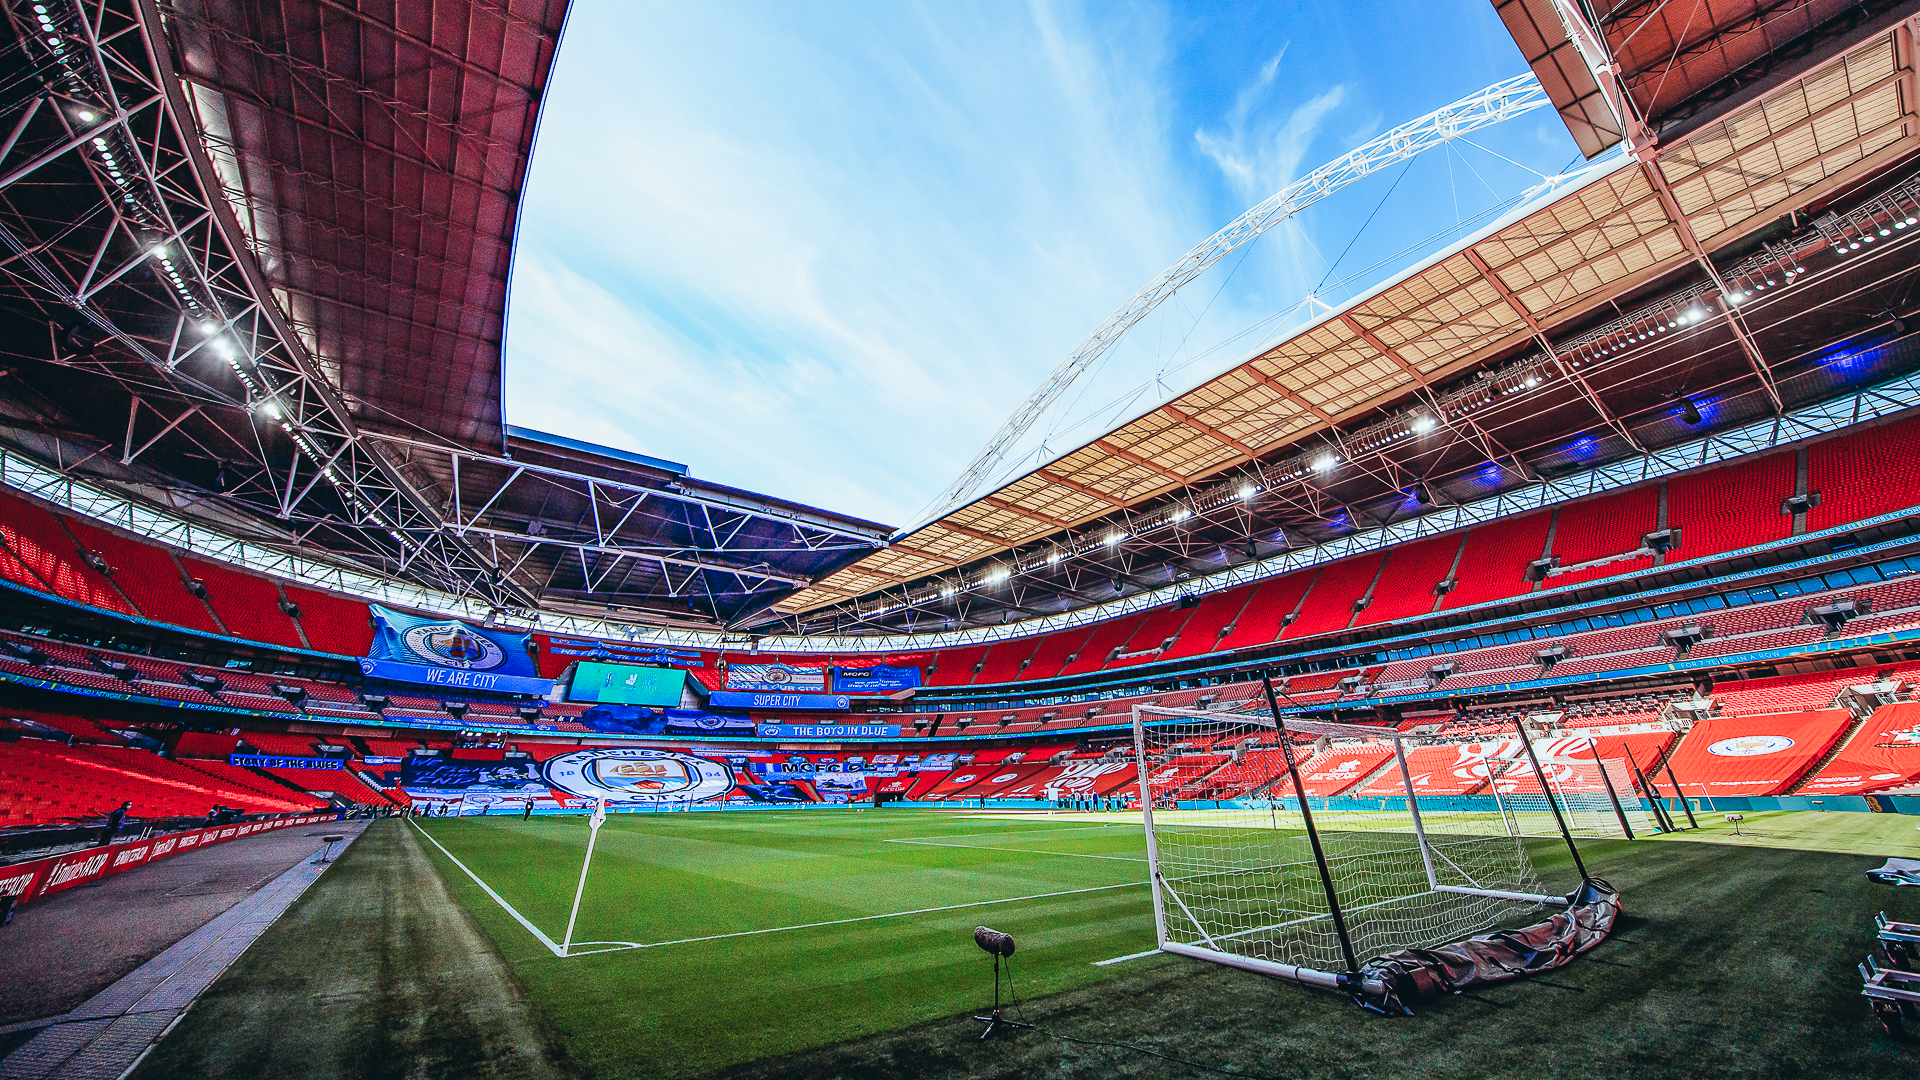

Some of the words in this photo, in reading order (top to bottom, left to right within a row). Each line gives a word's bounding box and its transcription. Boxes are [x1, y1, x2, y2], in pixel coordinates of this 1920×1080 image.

[1861, 511, 1899, 527] WEMBLEY
[1757, 538, 1790, 553] WEMBLEY
[1791, 527, 1836, 545] CONNECTED
[1832, 545, 1865, 560] WEMBLEY
[1868, 535, 1914, 552] CONNECTED
[1706, 656, 1735, 666] YEARS
[426, 669, 444, 683] WE
[446, 671, 470, 686] ARE
[472, 674, 498, 688] CITY
[754, 694, 781, 706] SUPER
[782, 696, 802, 706] CITY
[205, 704, 222, 712] YEARS
[793, 726, 814, 736] THE
[847, 726, 858, 735] IN
[234, 756, 266, 766] STORY
[270, 758, 282, 767] OF
[285, 760, 303, 768] THE
[306, 760, 338, 770] BLUES
[410, 756, 443, 766] WE
[782, 764, 841, 772] MCFC
[50, 860, 86, 886] Emirates
[87, 853, 109, 877] CUP
